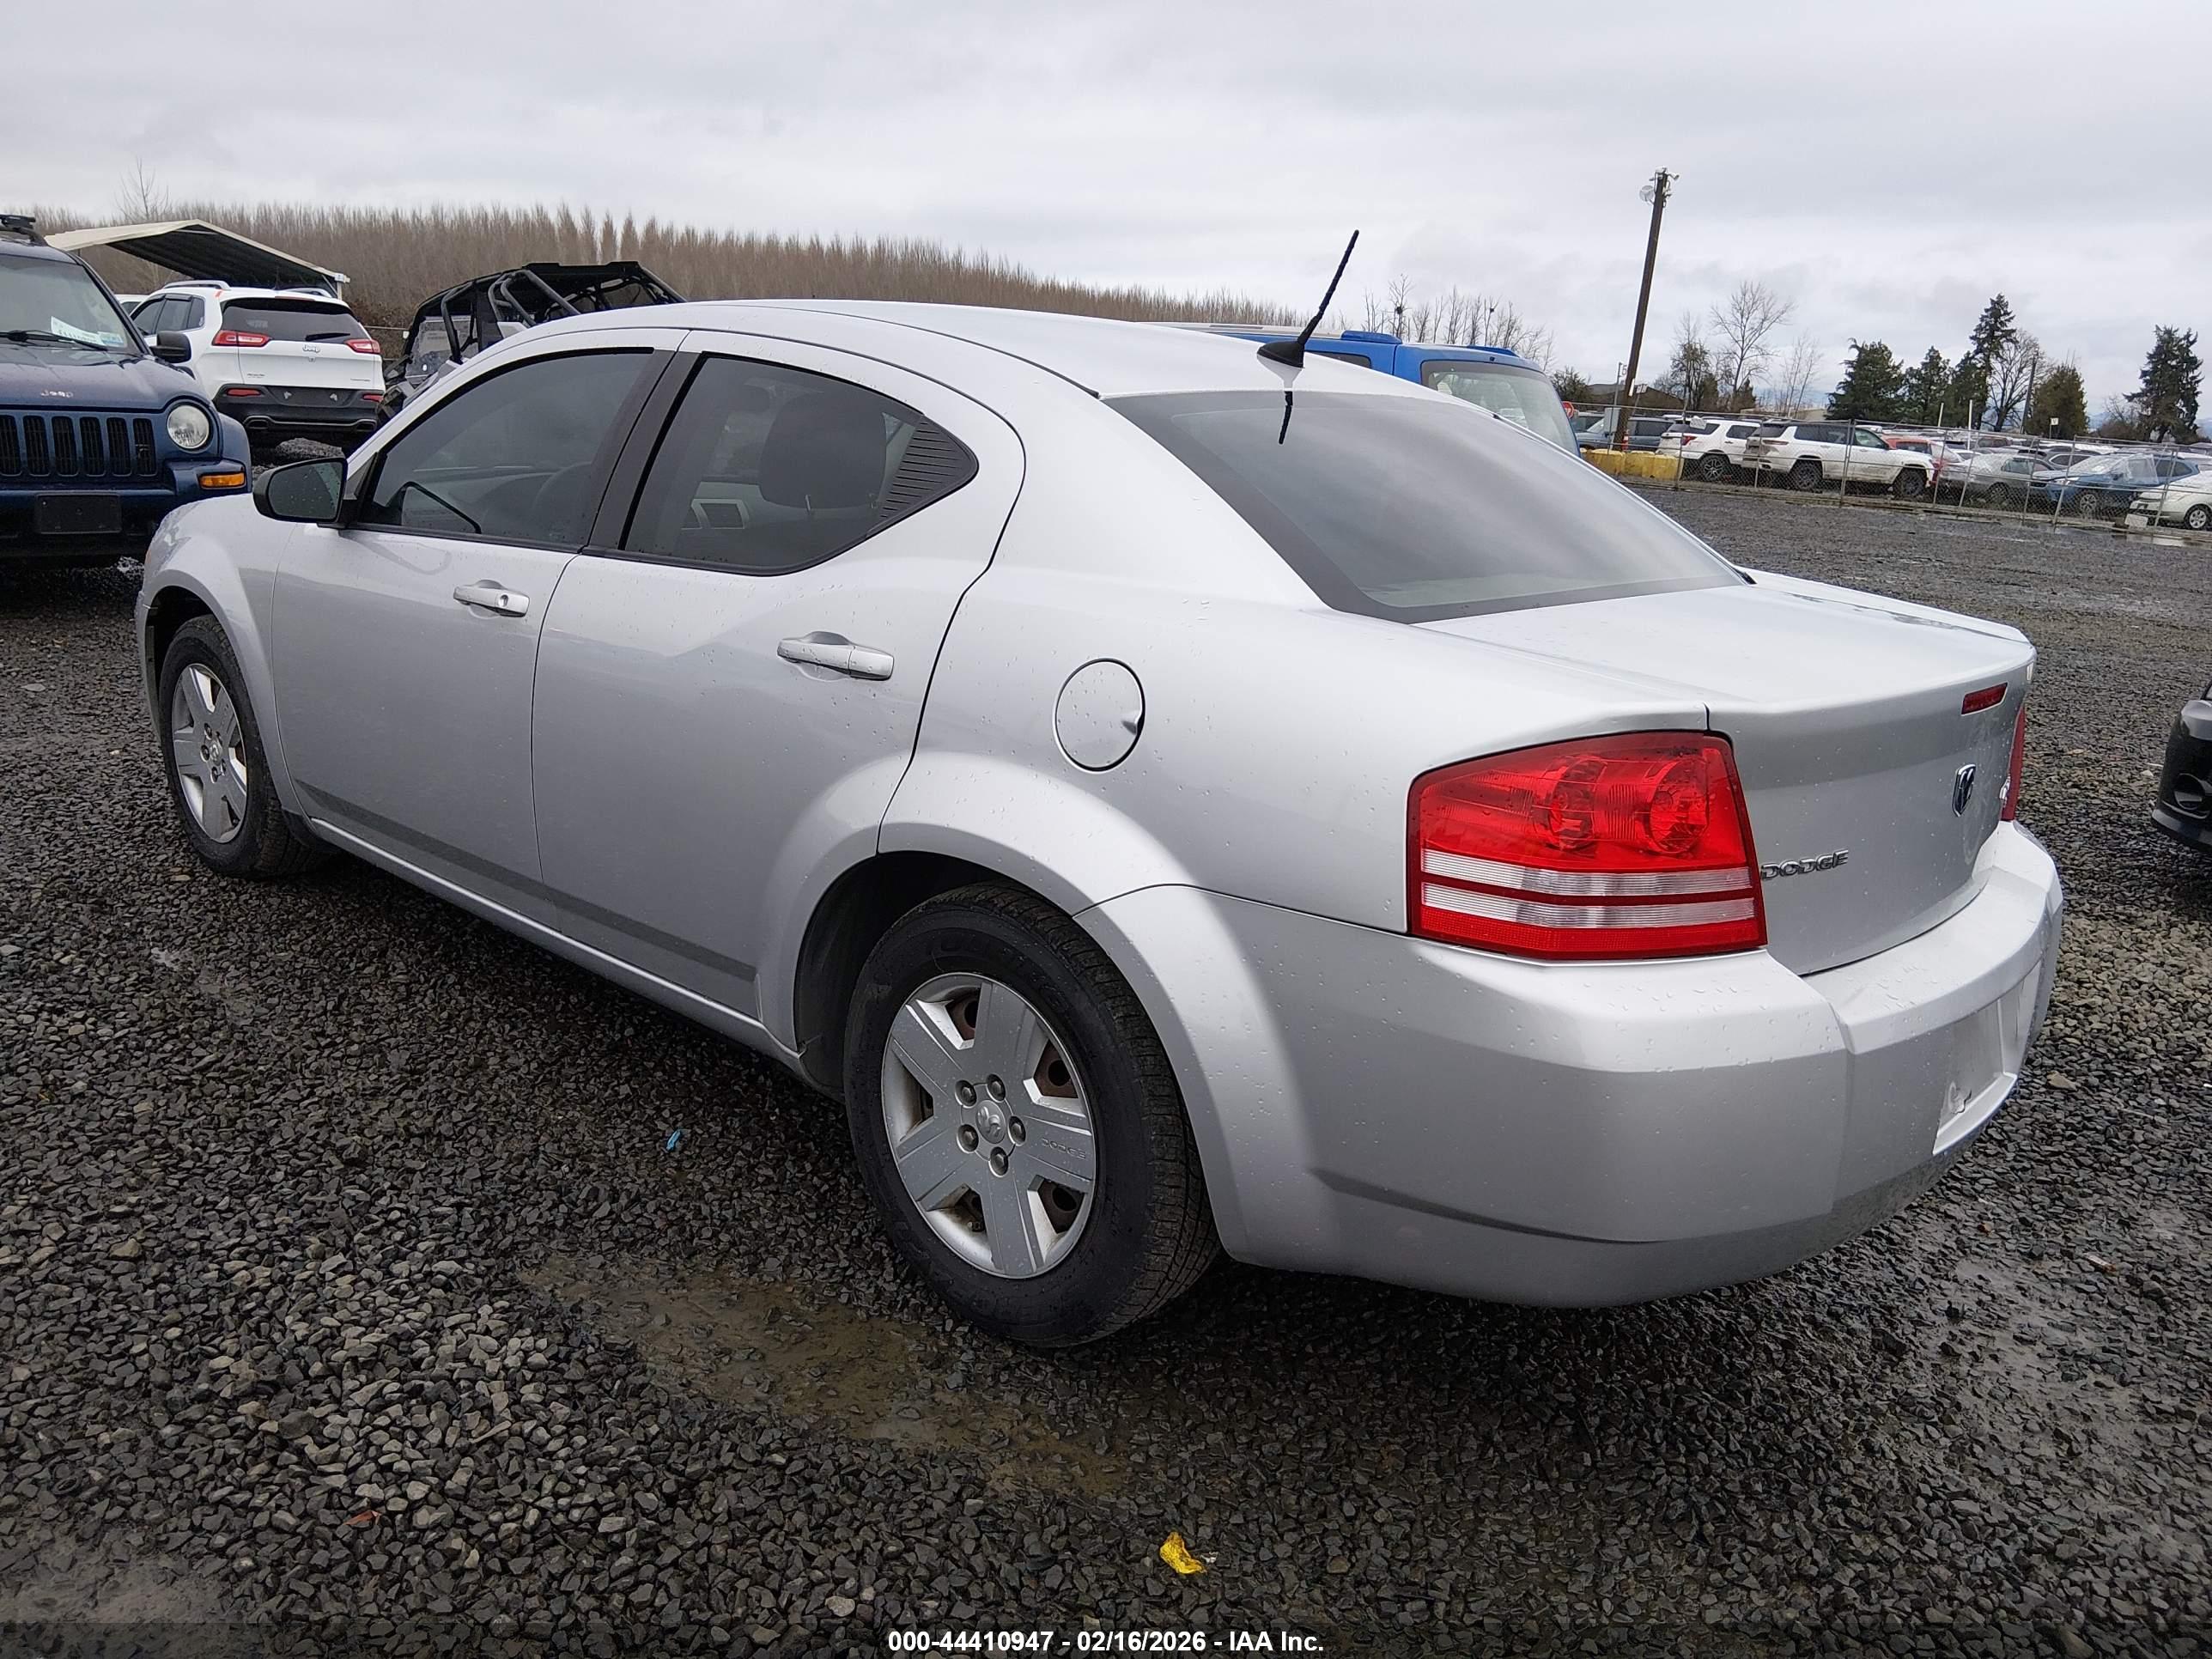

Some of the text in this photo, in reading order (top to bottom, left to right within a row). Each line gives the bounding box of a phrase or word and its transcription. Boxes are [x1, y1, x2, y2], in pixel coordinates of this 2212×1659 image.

[302, 344, 320, 353] Jeep
[1760, 849, 1849, 880] DODGE
[1041, 1138, 1086, 1160] DODGE
